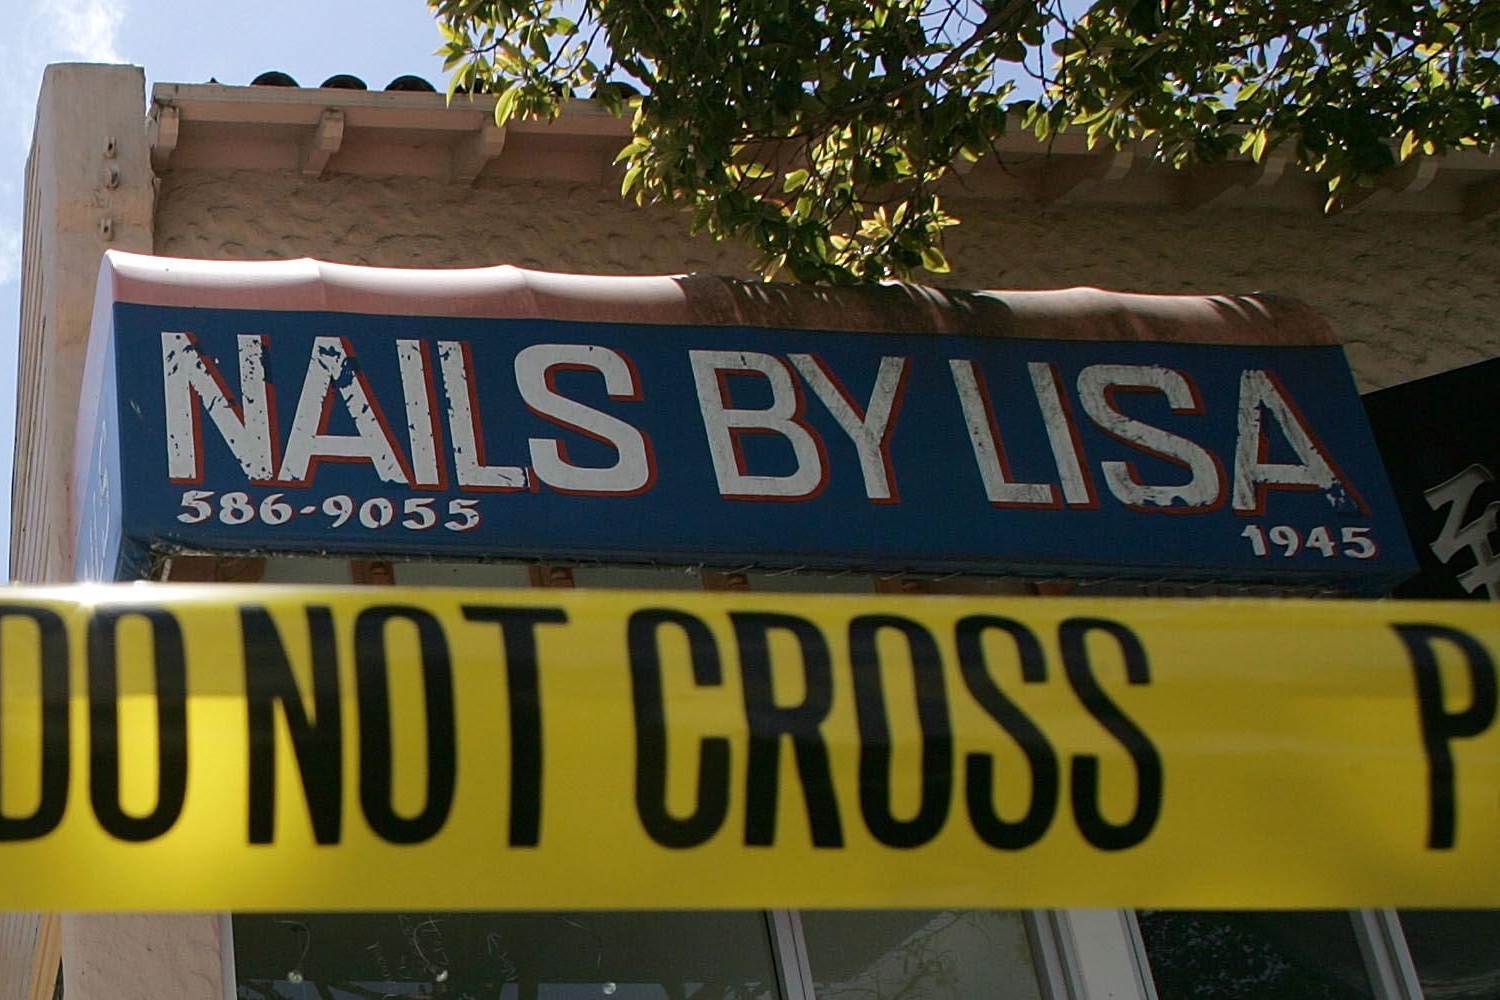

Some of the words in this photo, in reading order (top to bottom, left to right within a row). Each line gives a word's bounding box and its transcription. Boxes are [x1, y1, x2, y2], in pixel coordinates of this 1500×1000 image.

[161, 332, 656, 497] NAILS
[689, 350, 907, 503] BY
[949, 359, 1368, 515] LISA
[177, 489, 483, 533] 586-9055
[1240, 524, 1378, 561] 1945
[238, 604, 570, 848] NOT
[626, 607, 1165, 852] CROSS
